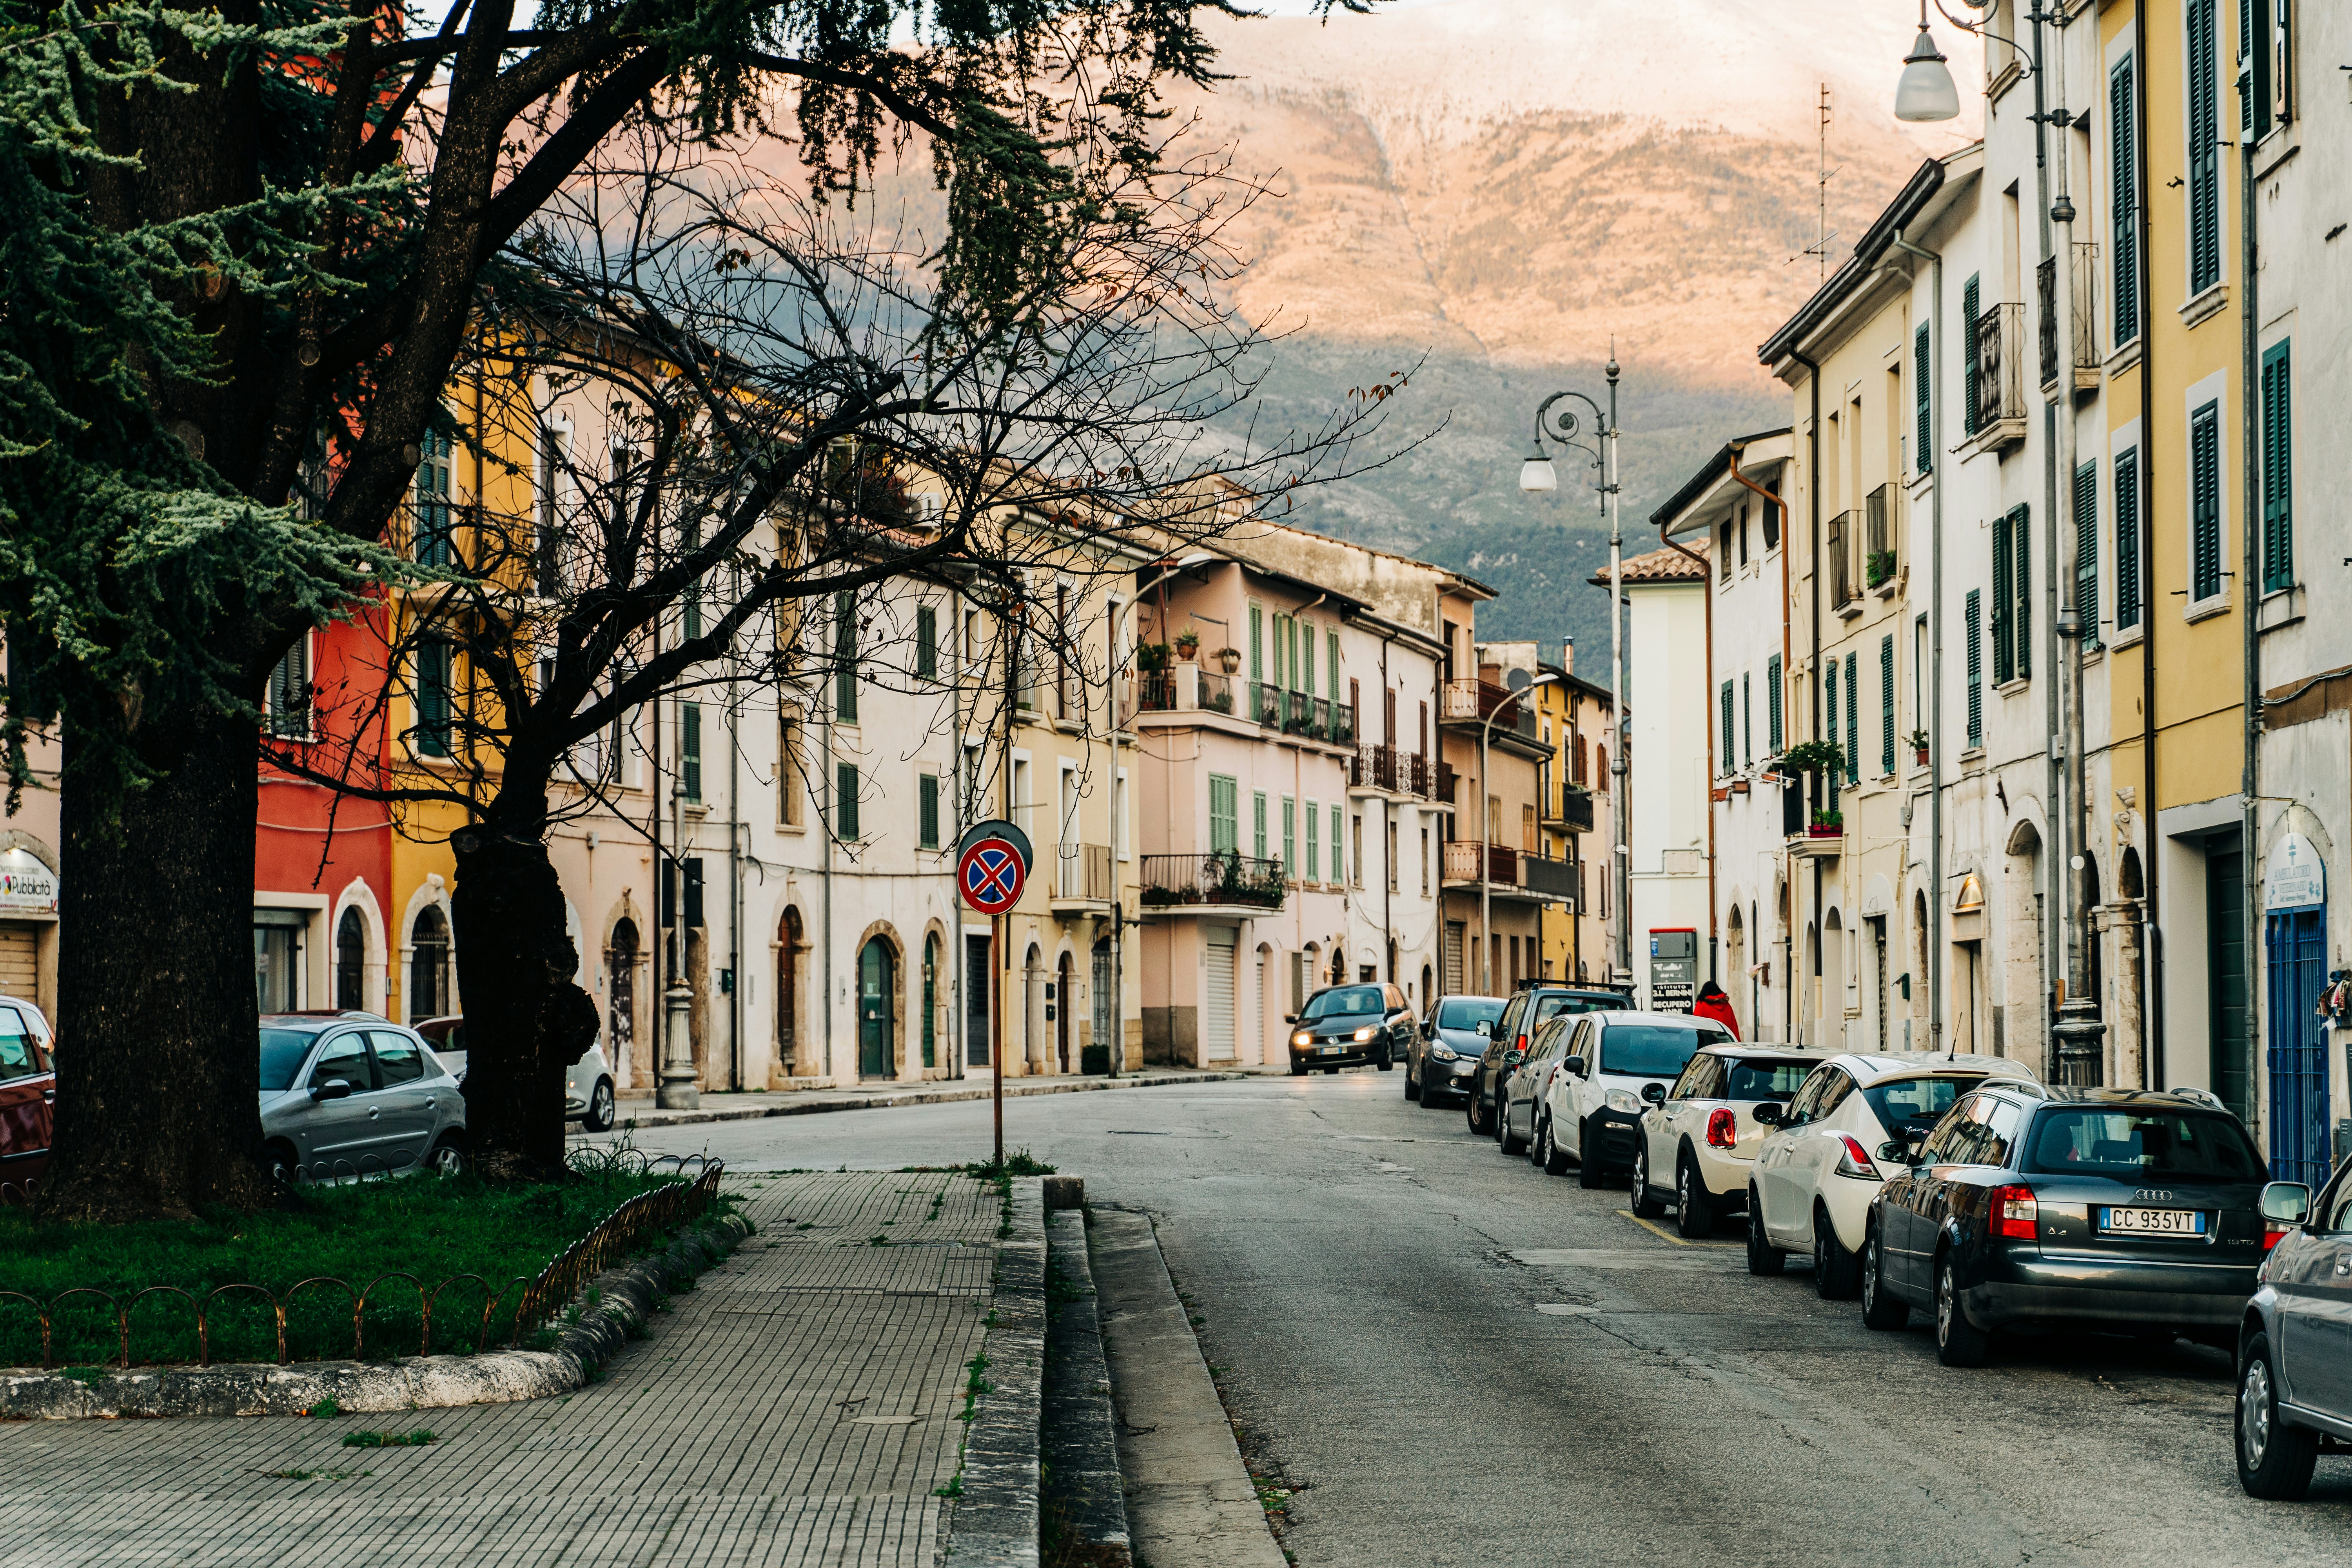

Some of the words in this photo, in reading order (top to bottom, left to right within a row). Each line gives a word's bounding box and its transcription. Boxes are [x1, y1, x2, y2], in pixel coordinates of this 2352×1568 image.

[2274, 864, 2311, 881] AMBULATORIO
[12, 876, 50, 896] Pubblicità
[1653, 1000, 1691, 1008] RECUPERO
[2113, 1209, 2133, 1227] CC
[2141, 1211, 2193, 1230] 935VT
